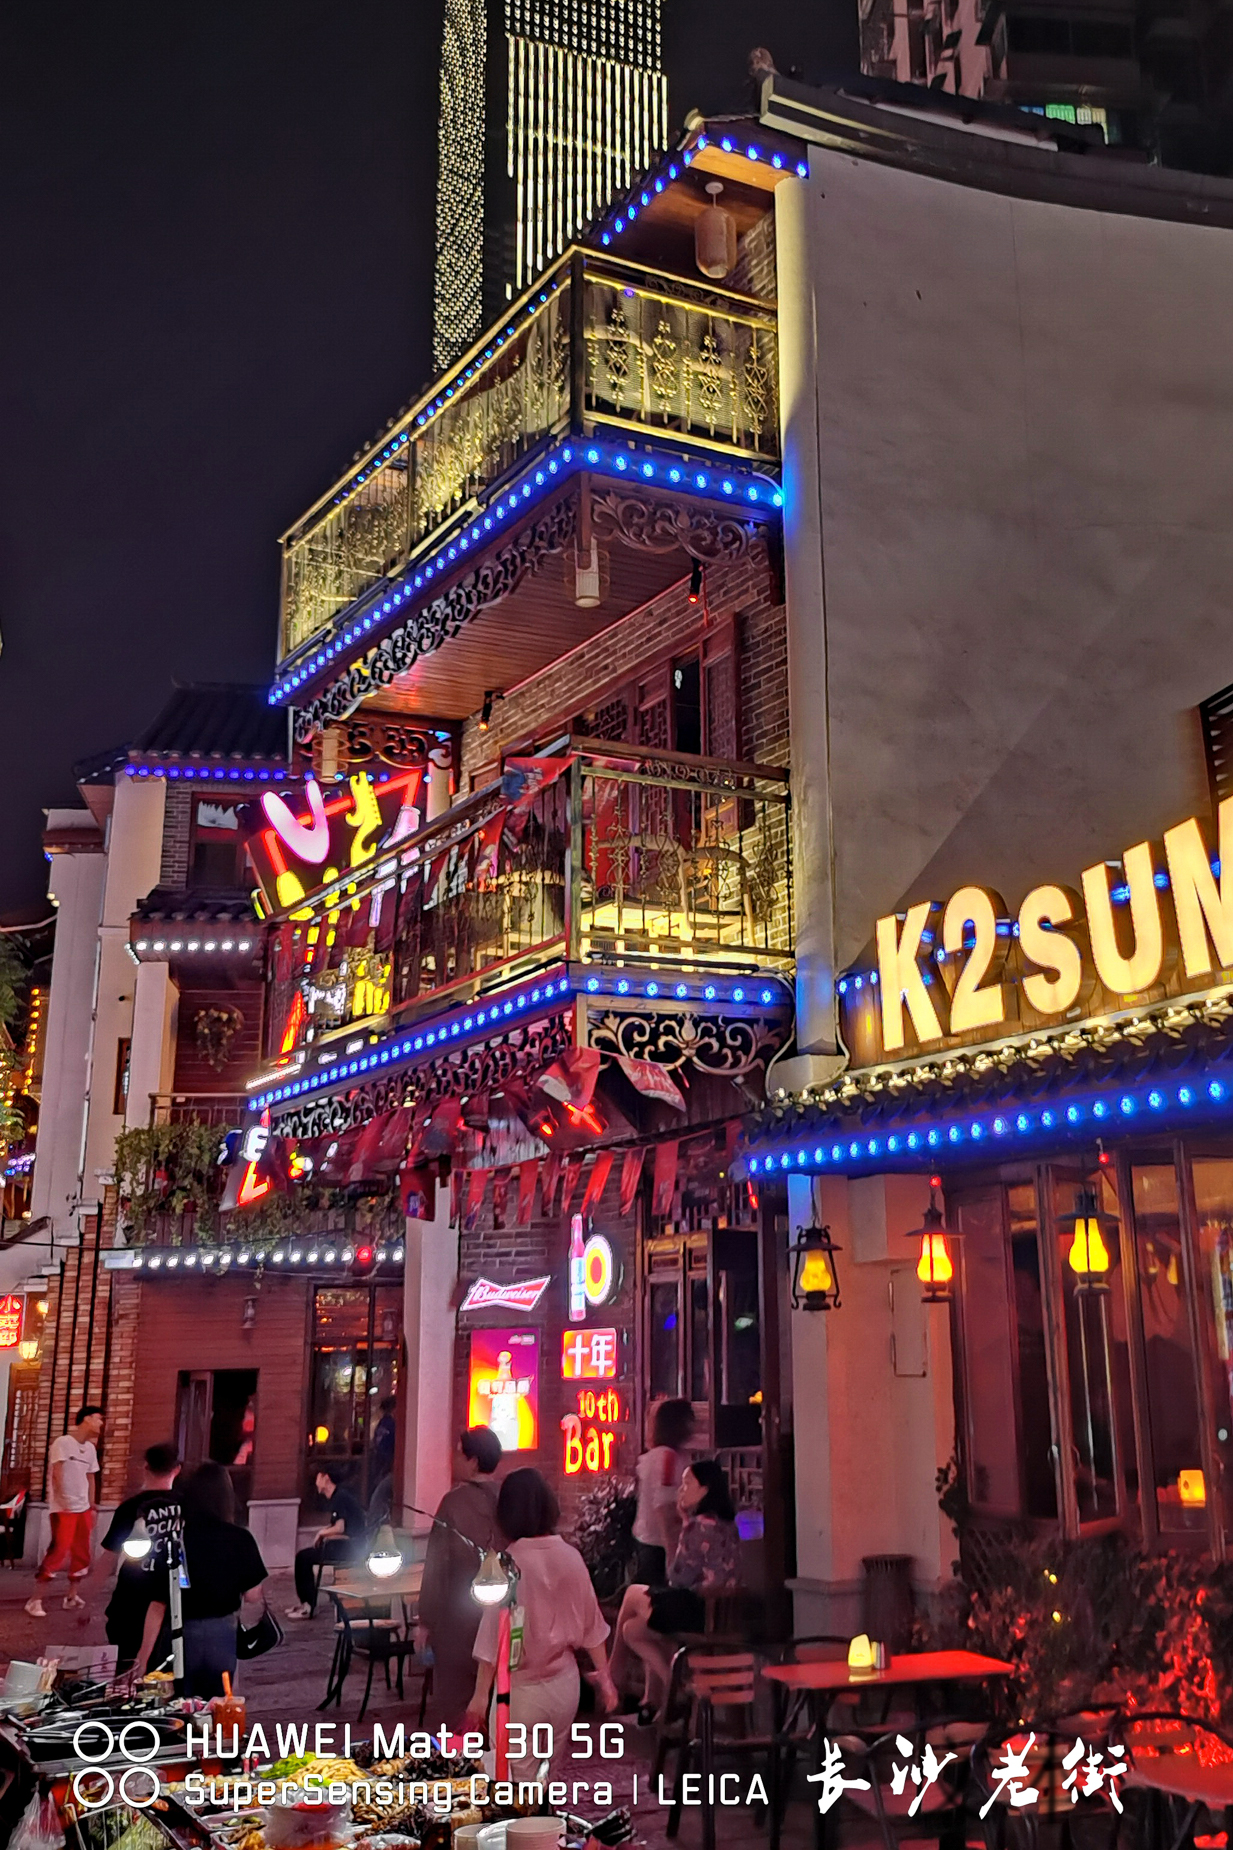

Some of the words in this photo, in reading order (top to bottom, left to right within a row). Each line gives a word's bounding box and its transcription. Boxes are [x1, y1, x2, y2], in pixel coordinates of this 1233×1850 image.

[566, 1333, 613, 1378] 十年
[577, 1386, 619, 1423] 10th
[561, 1412, 615, 1476] Bar
[147, 1504, 181, 1521] ANTI
